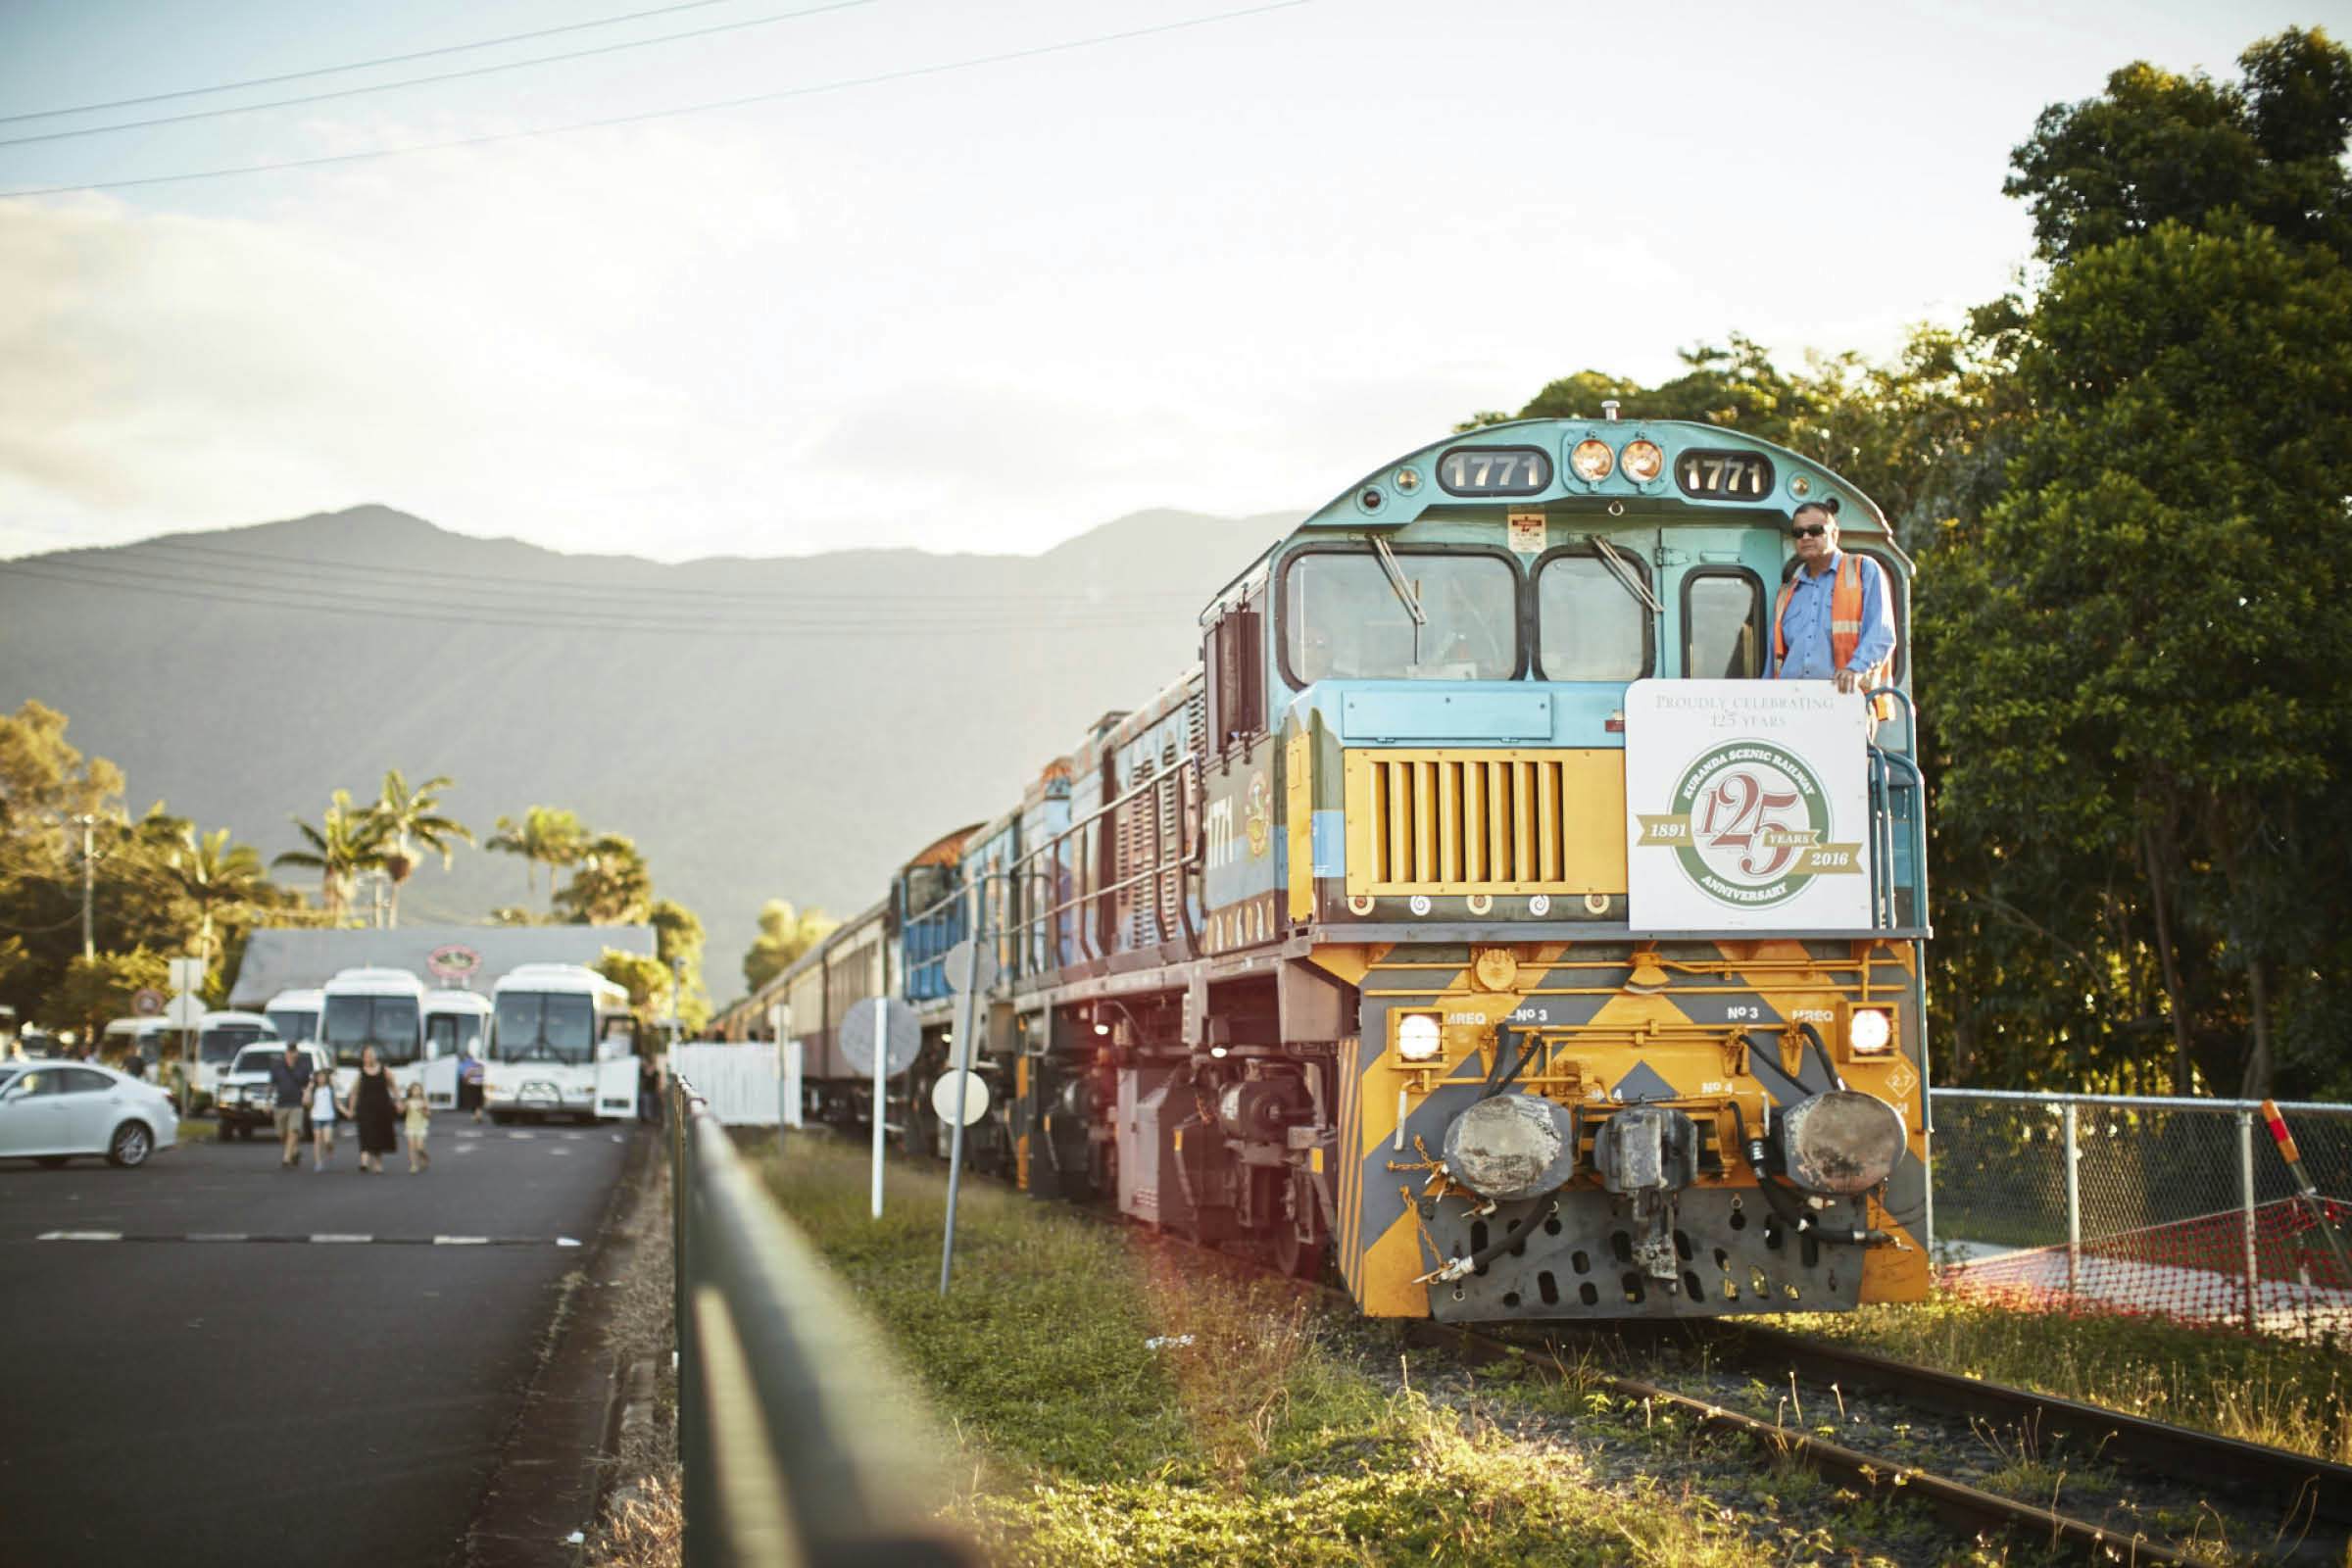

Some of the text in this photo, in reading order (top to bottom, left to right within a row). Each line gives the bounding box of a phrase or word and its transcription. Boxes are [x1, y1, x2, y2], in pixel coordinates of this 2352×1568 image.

[1447, 455, 1540, 487] 1771
[1684, 457, 1762, 494] 1771
[1654, 694, 1835, 710] PROUDLY CELEBRATING
[1710, 710, 1788, 728] 125 YEARS
[1682, 749, 1816, 801] KURANDA SCENIC RAILWAY
[1649, 822, 1687, 838] 1891
[1696, 772, 1800, 876] 125
[1769, 833, 1810, 845] YEARS
[1810, 852, 1849, 866] 2016
[1700, 875, 1788, 903] ANNIVERSARY
[1538, 1008, 1548, 1022] 3
[1749, 1006, 1759, 1019] 3
